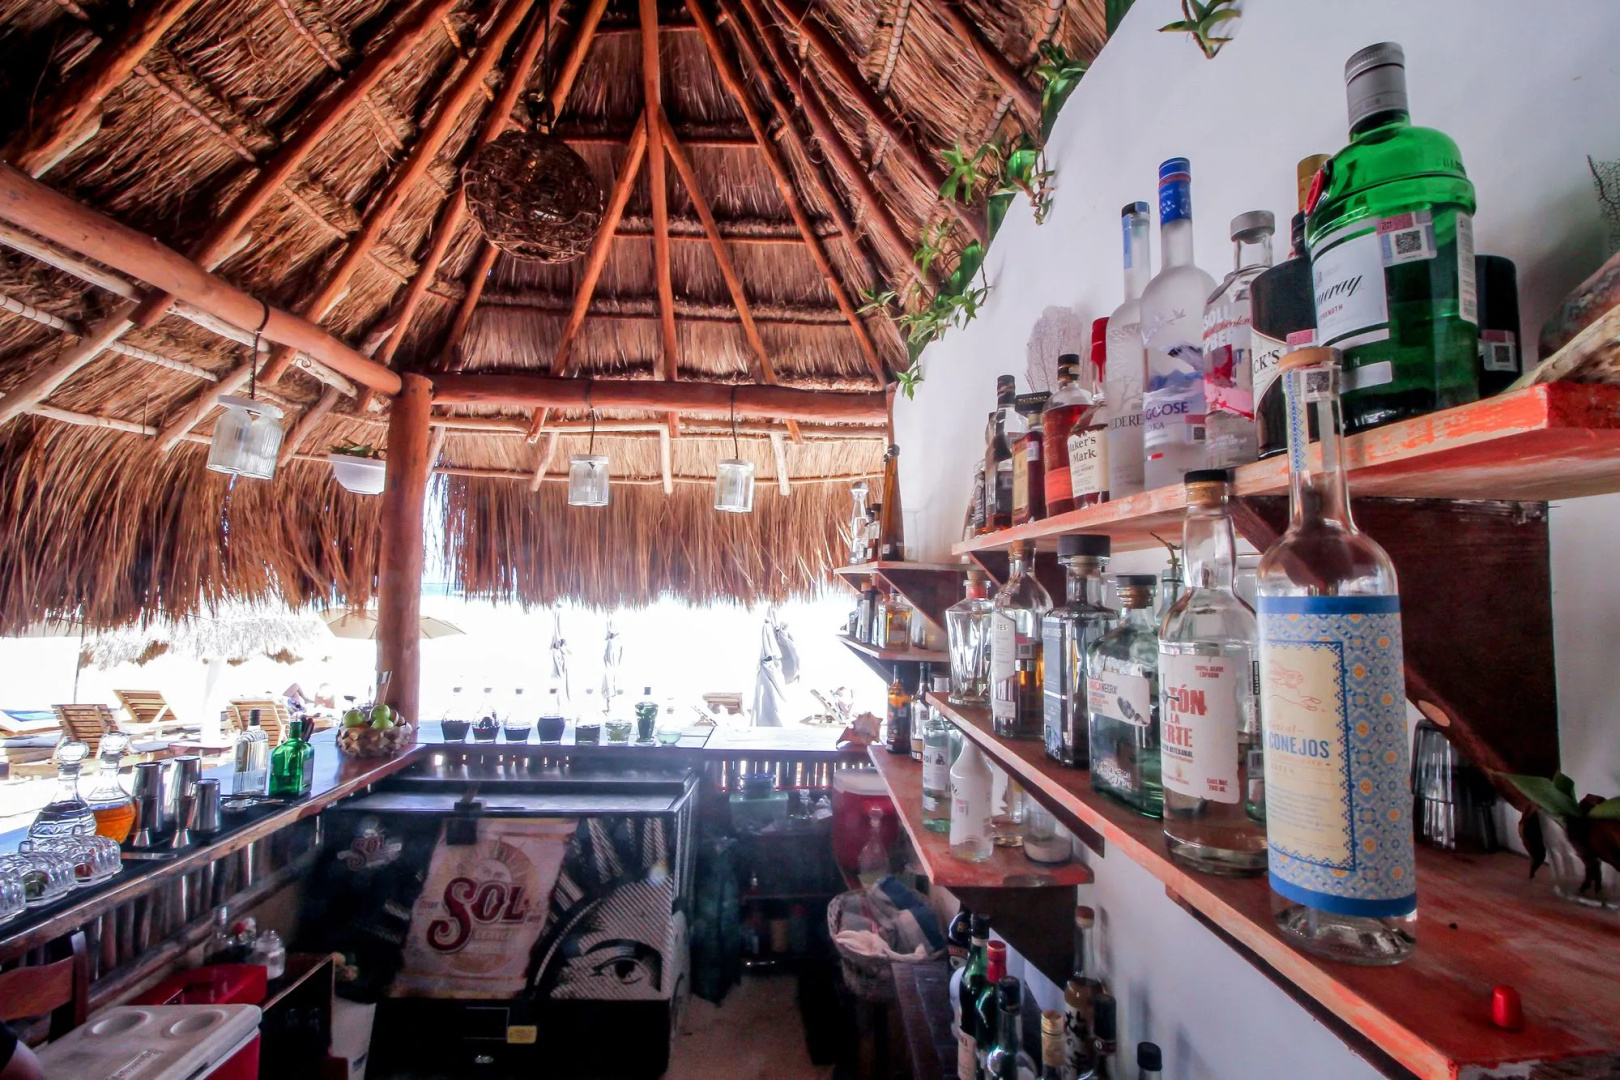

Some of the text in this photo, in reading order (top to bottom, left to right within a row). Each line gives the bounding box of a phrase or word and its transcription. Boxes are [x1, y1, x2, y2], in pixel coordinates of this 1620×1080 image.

[1145, 401, 1190, 420] GOOSE
[1170, 712, 1180, 724] LA
[1268, 731, 1330, 759] CONEJOS
[426, 876, 526, 953] SOL
